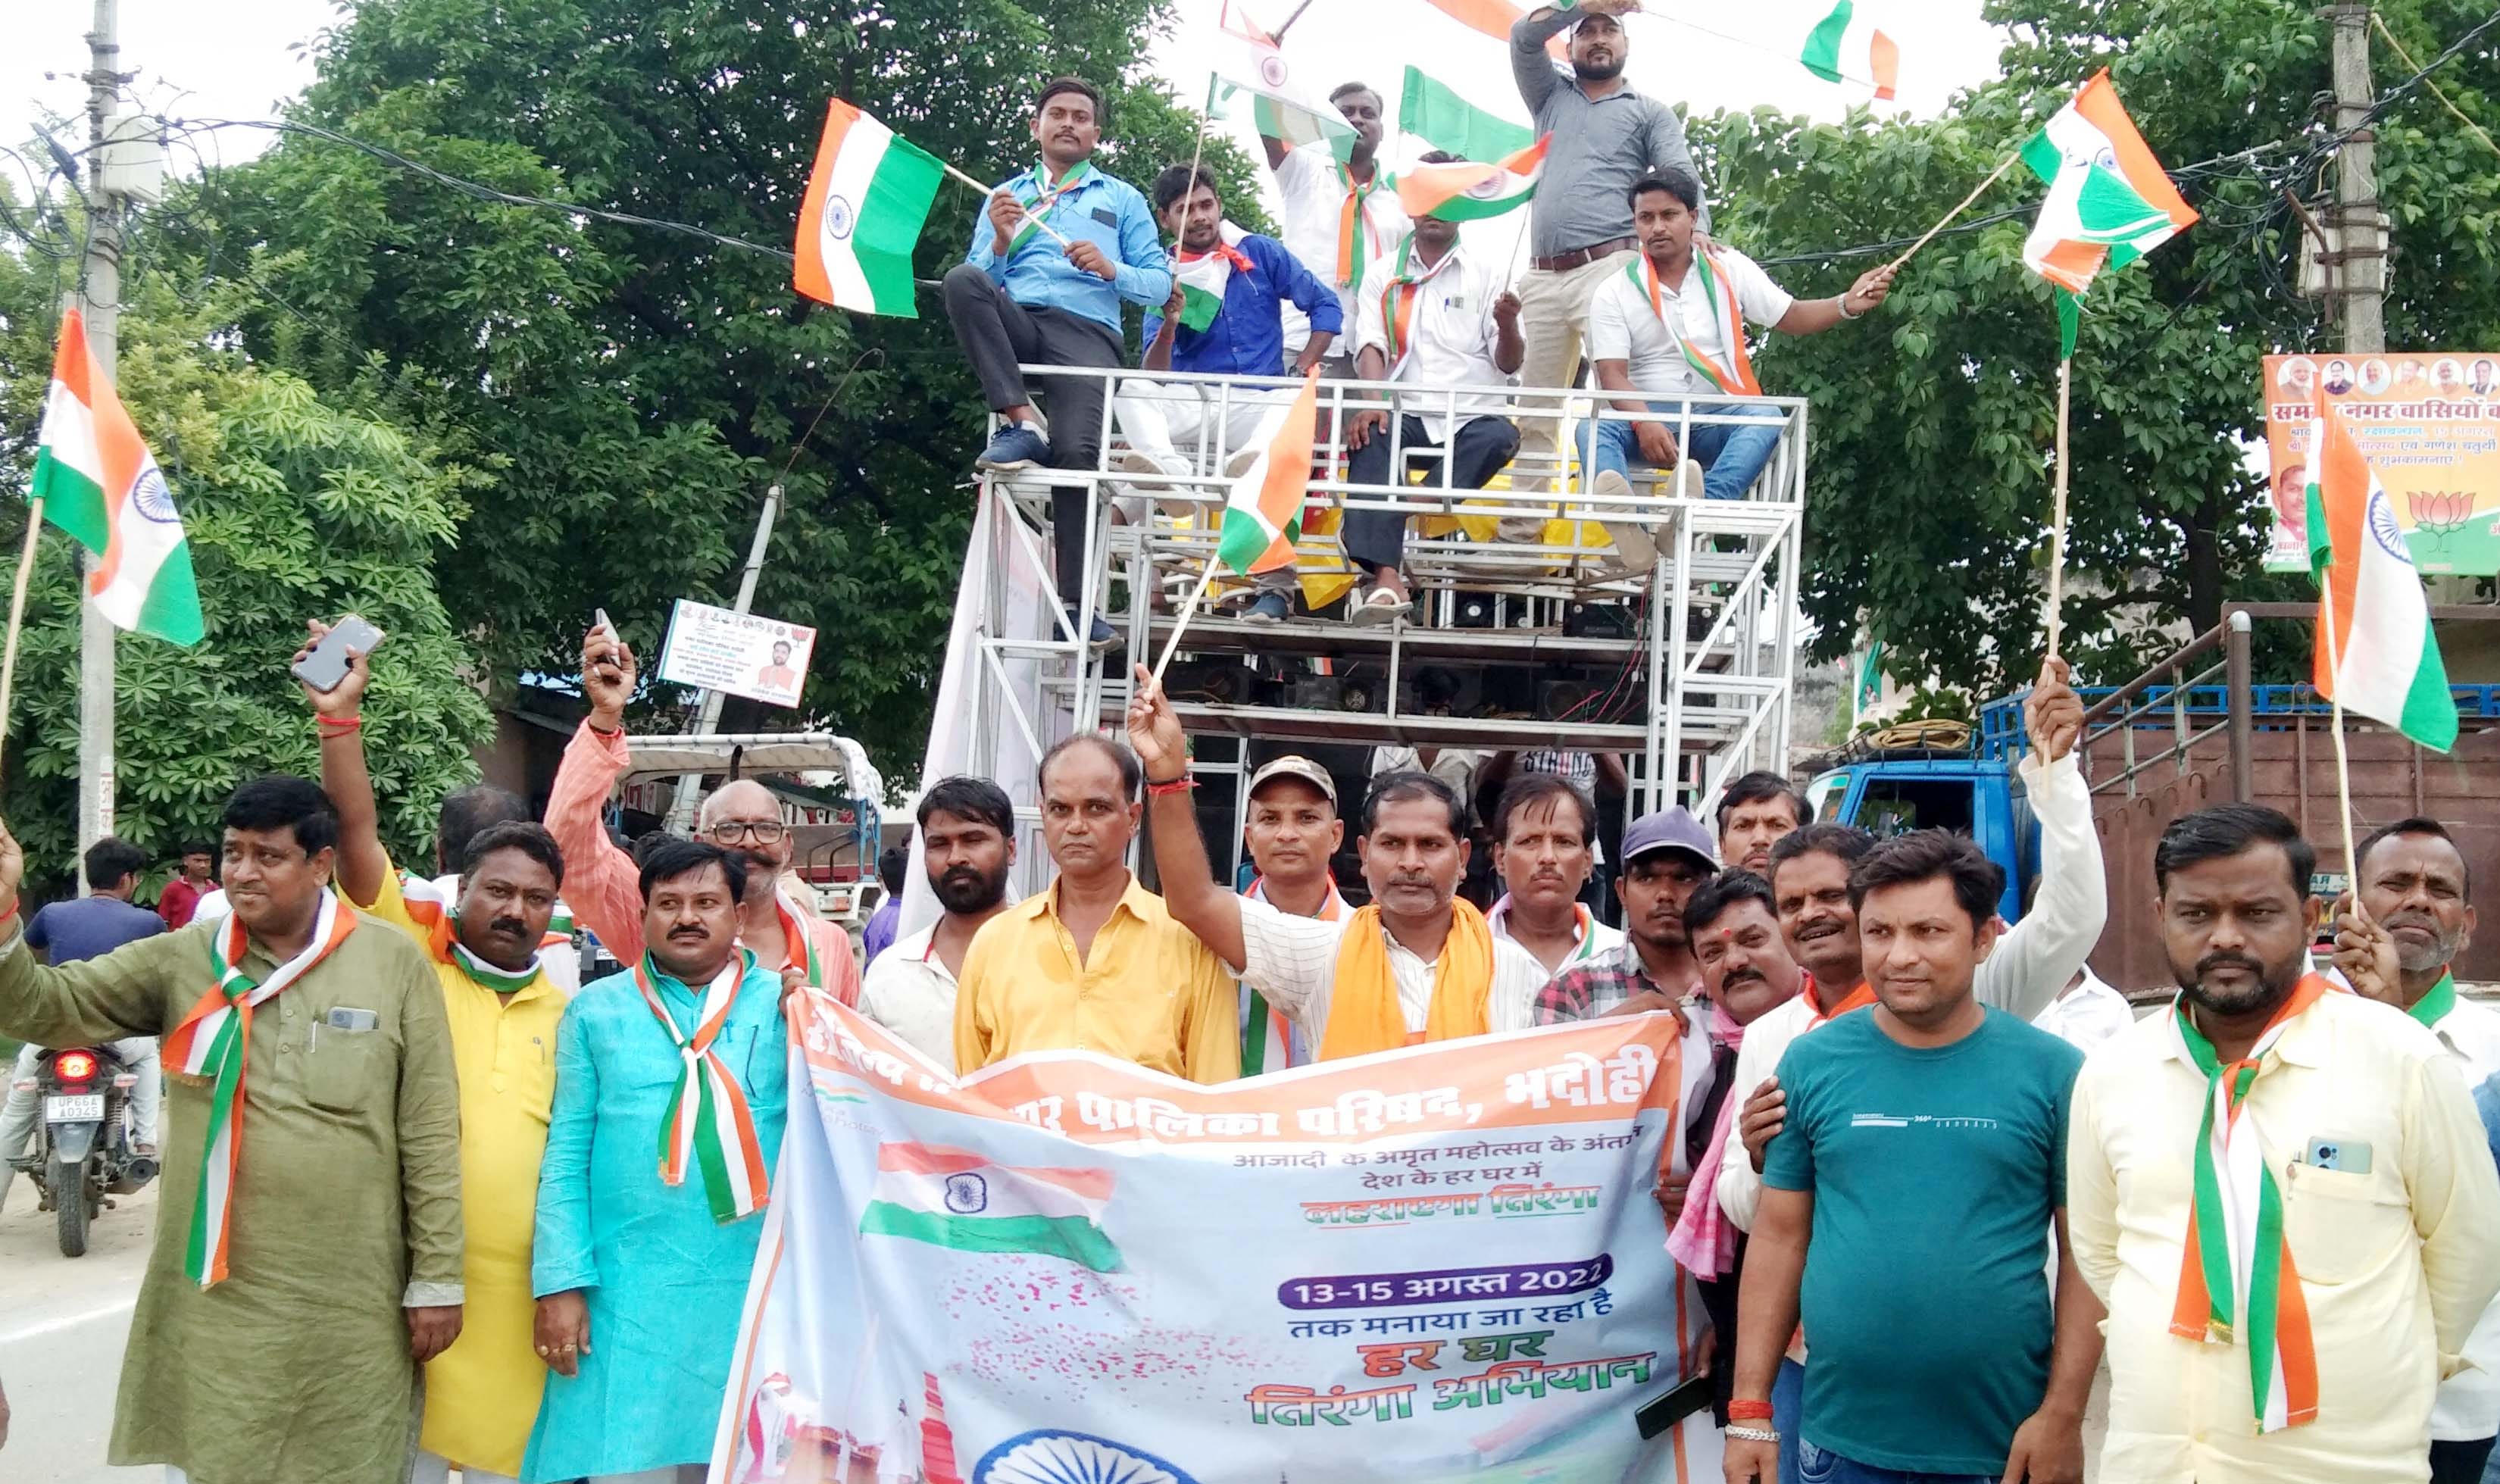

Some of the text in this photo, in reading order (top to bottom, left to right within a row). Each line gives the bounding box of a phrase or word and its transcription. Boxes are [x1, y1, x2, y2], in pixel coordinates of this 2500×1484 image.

[2345, 405, 2397, 419] नगर
[2399, 399, 2483, 419] वासियों
[1076, 1091, 1281, 1137] पालिका
[1505, 1044, 1659, 1108] भदोही
[1233, 1151, 1327, 1169] आजादी
[1341, 1150, 1367, 1167] के
[1375, 1146, 1439, 1168] अमृत
[1445, 1139, 1541, 1161] महोत्सव
[1551, 1136, 1574, 1153] के
[1361, 1160, 1544, 1190] देश के हर घर में
[1486, 1182, 1602, 1214] तिरंगा
[1293, 1262, 1603, 1305] 13-15 अगस्त 2022
[1287, 1287, 1614, 1339] तक मनाया जा रहा है
[1356, 1329, 1555, 1378] हर घर
[1243, 1351, 1658, 1426] तिरंगा अभियान
